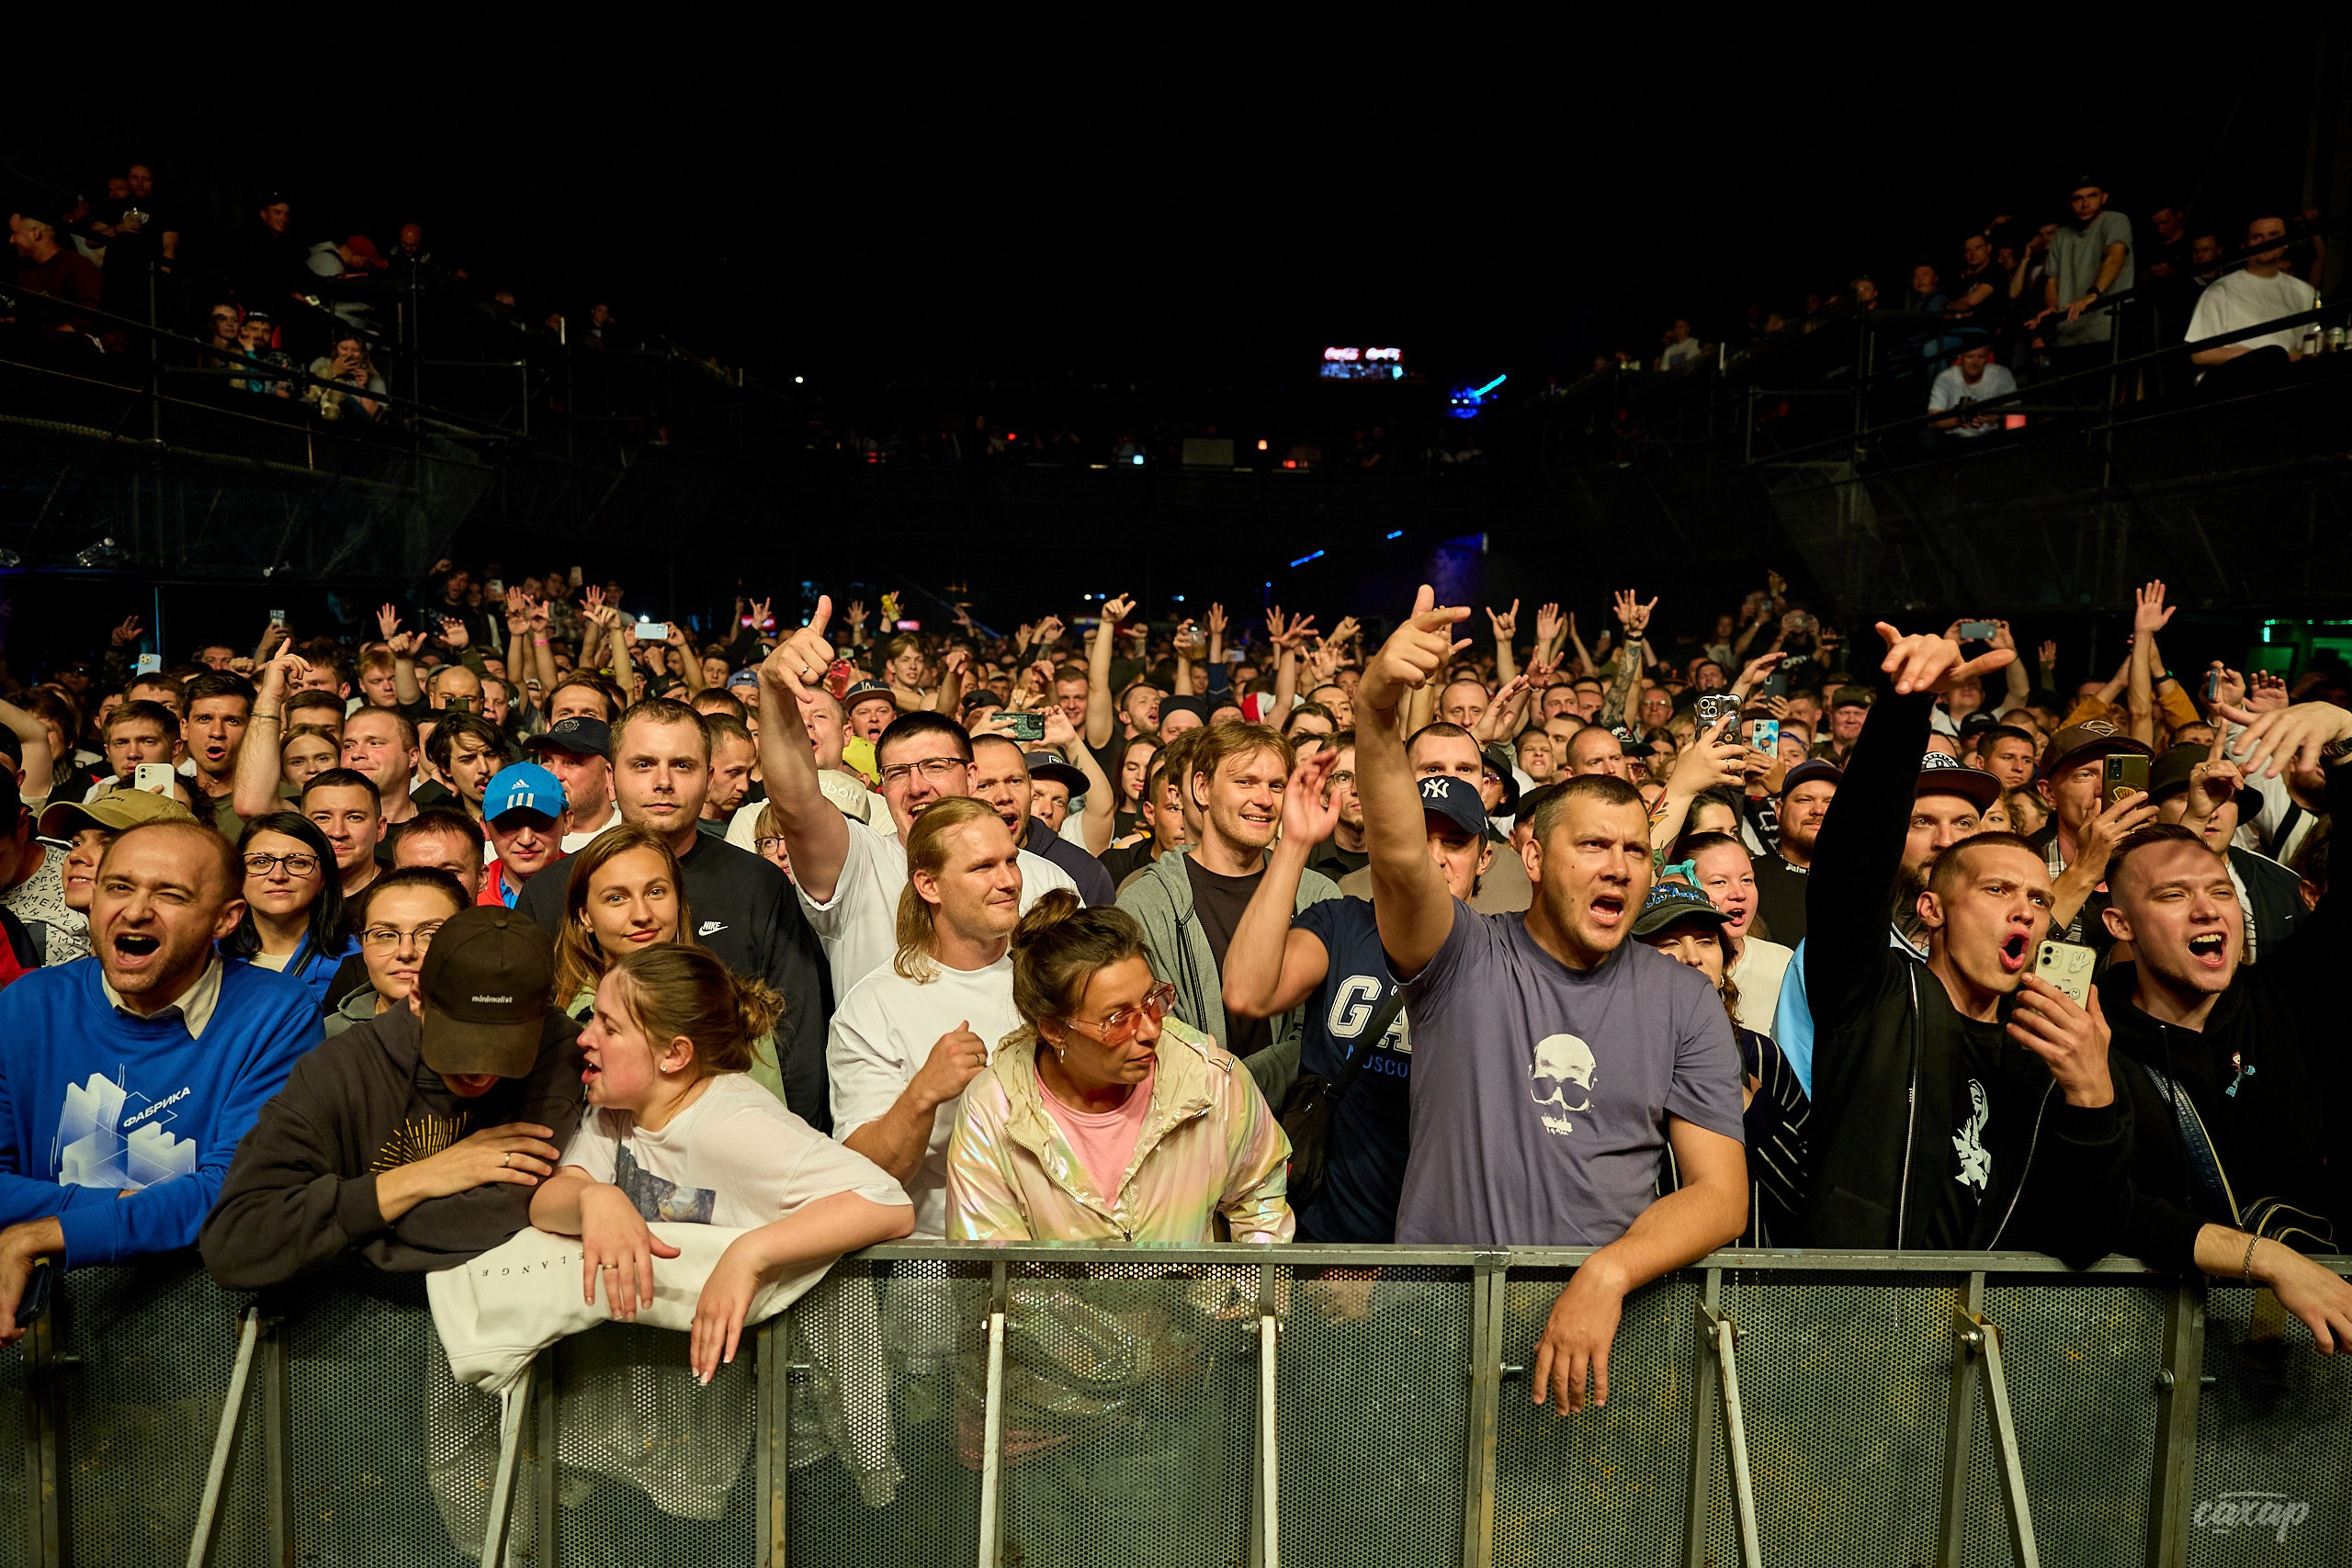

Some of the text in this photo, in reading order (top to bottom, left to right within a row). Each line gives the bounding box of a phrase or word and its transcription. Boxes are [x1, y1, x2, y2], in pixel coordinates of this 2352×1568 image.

[703, 920, 721, 931] NIKE
[471, 994, 513, 1003] minimalist
[1328, 975, 1412, 1054] GA
[123, 1086, 191, 1128] ФАБРИКА
